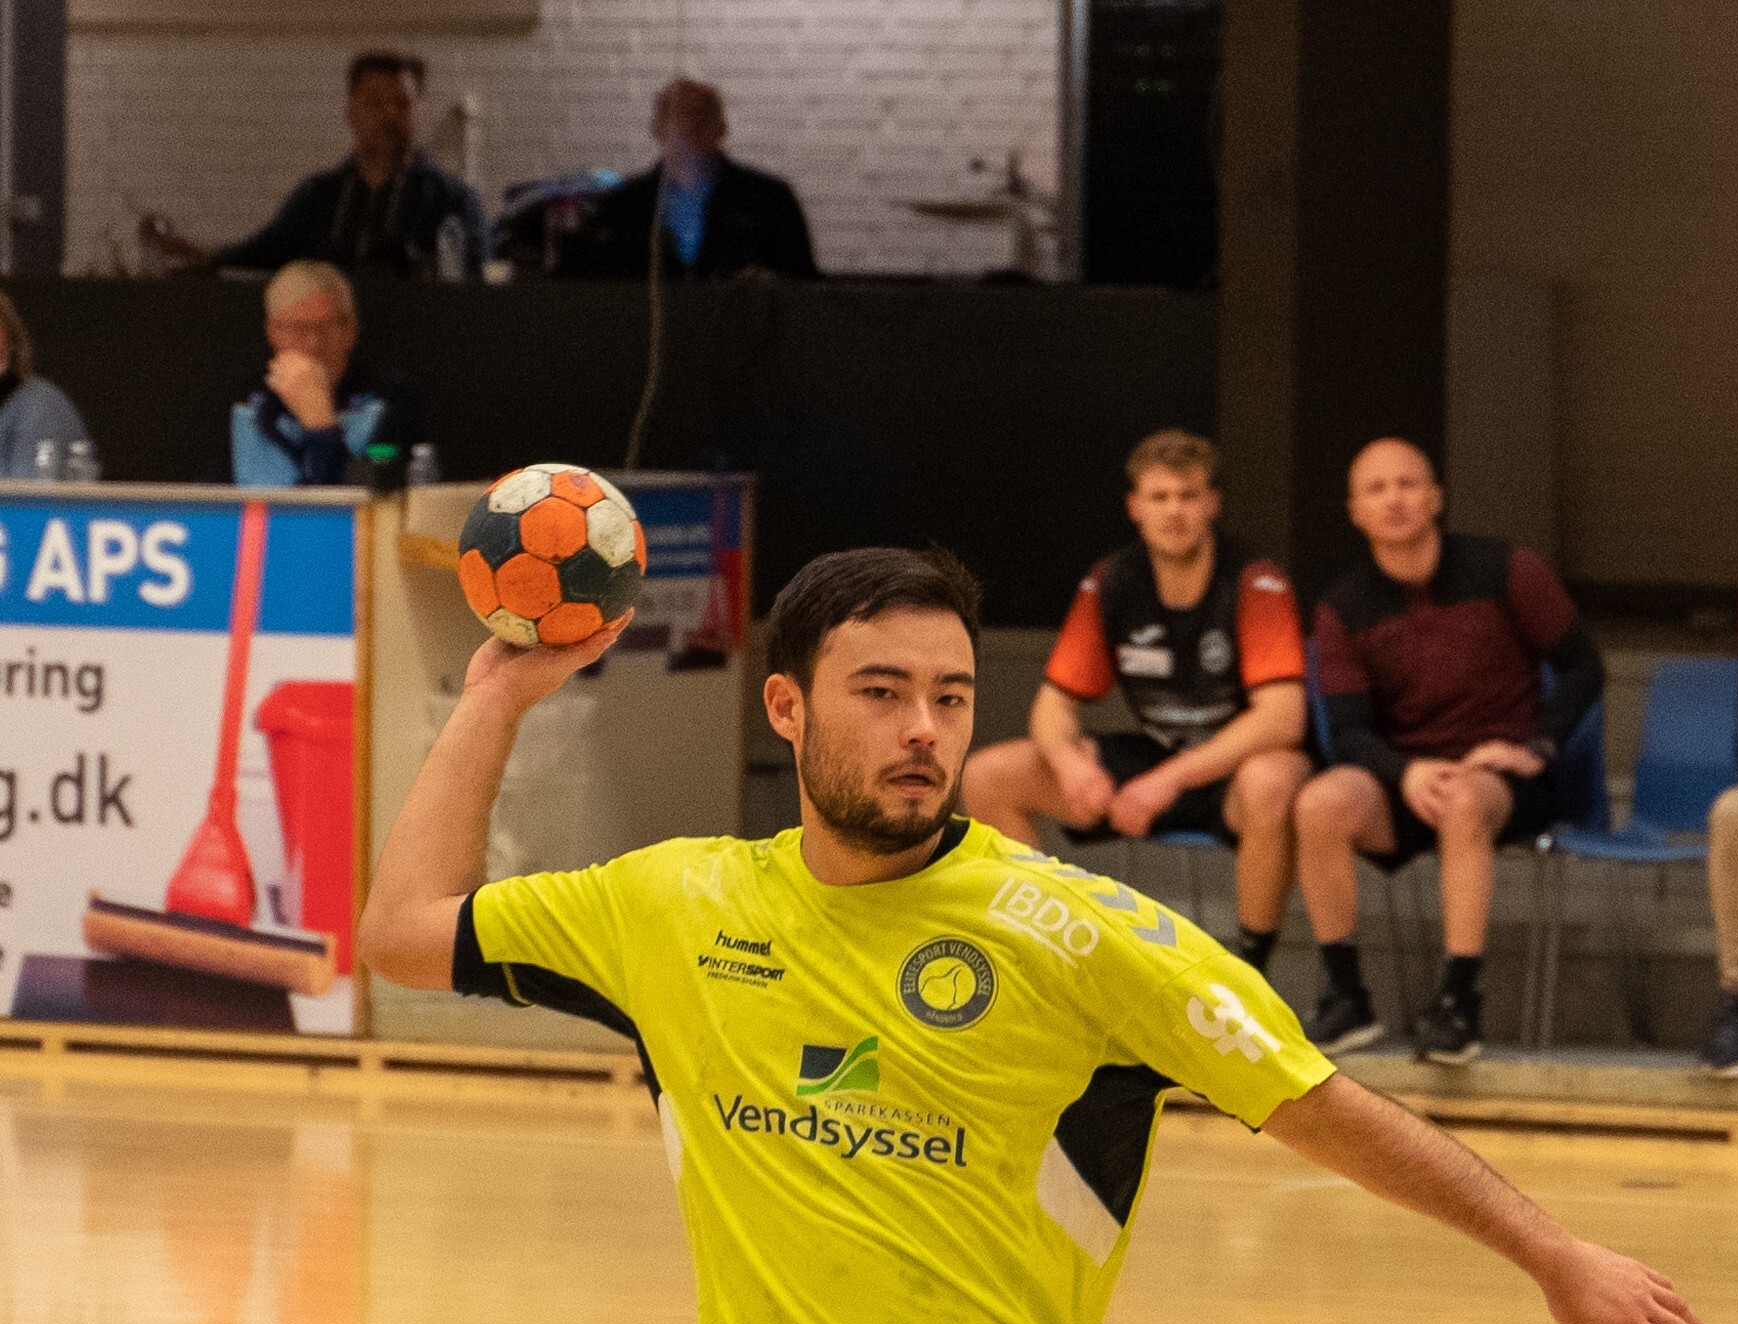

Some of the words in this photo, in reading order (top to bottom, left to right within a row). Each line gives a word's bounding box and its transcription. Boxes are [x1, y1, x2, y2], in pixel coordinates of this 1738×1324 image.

[27, 518, 193, 609] APS
[714, 929, 772, 957] hummel
[1005, 881, 1099, 957] BDO
[708, 956, 786, 981] INTERSPORT
[713, 1093, 968, 1168] Vendsyssel
[823, 1099, 951, 1127] SPAREKASSEN
